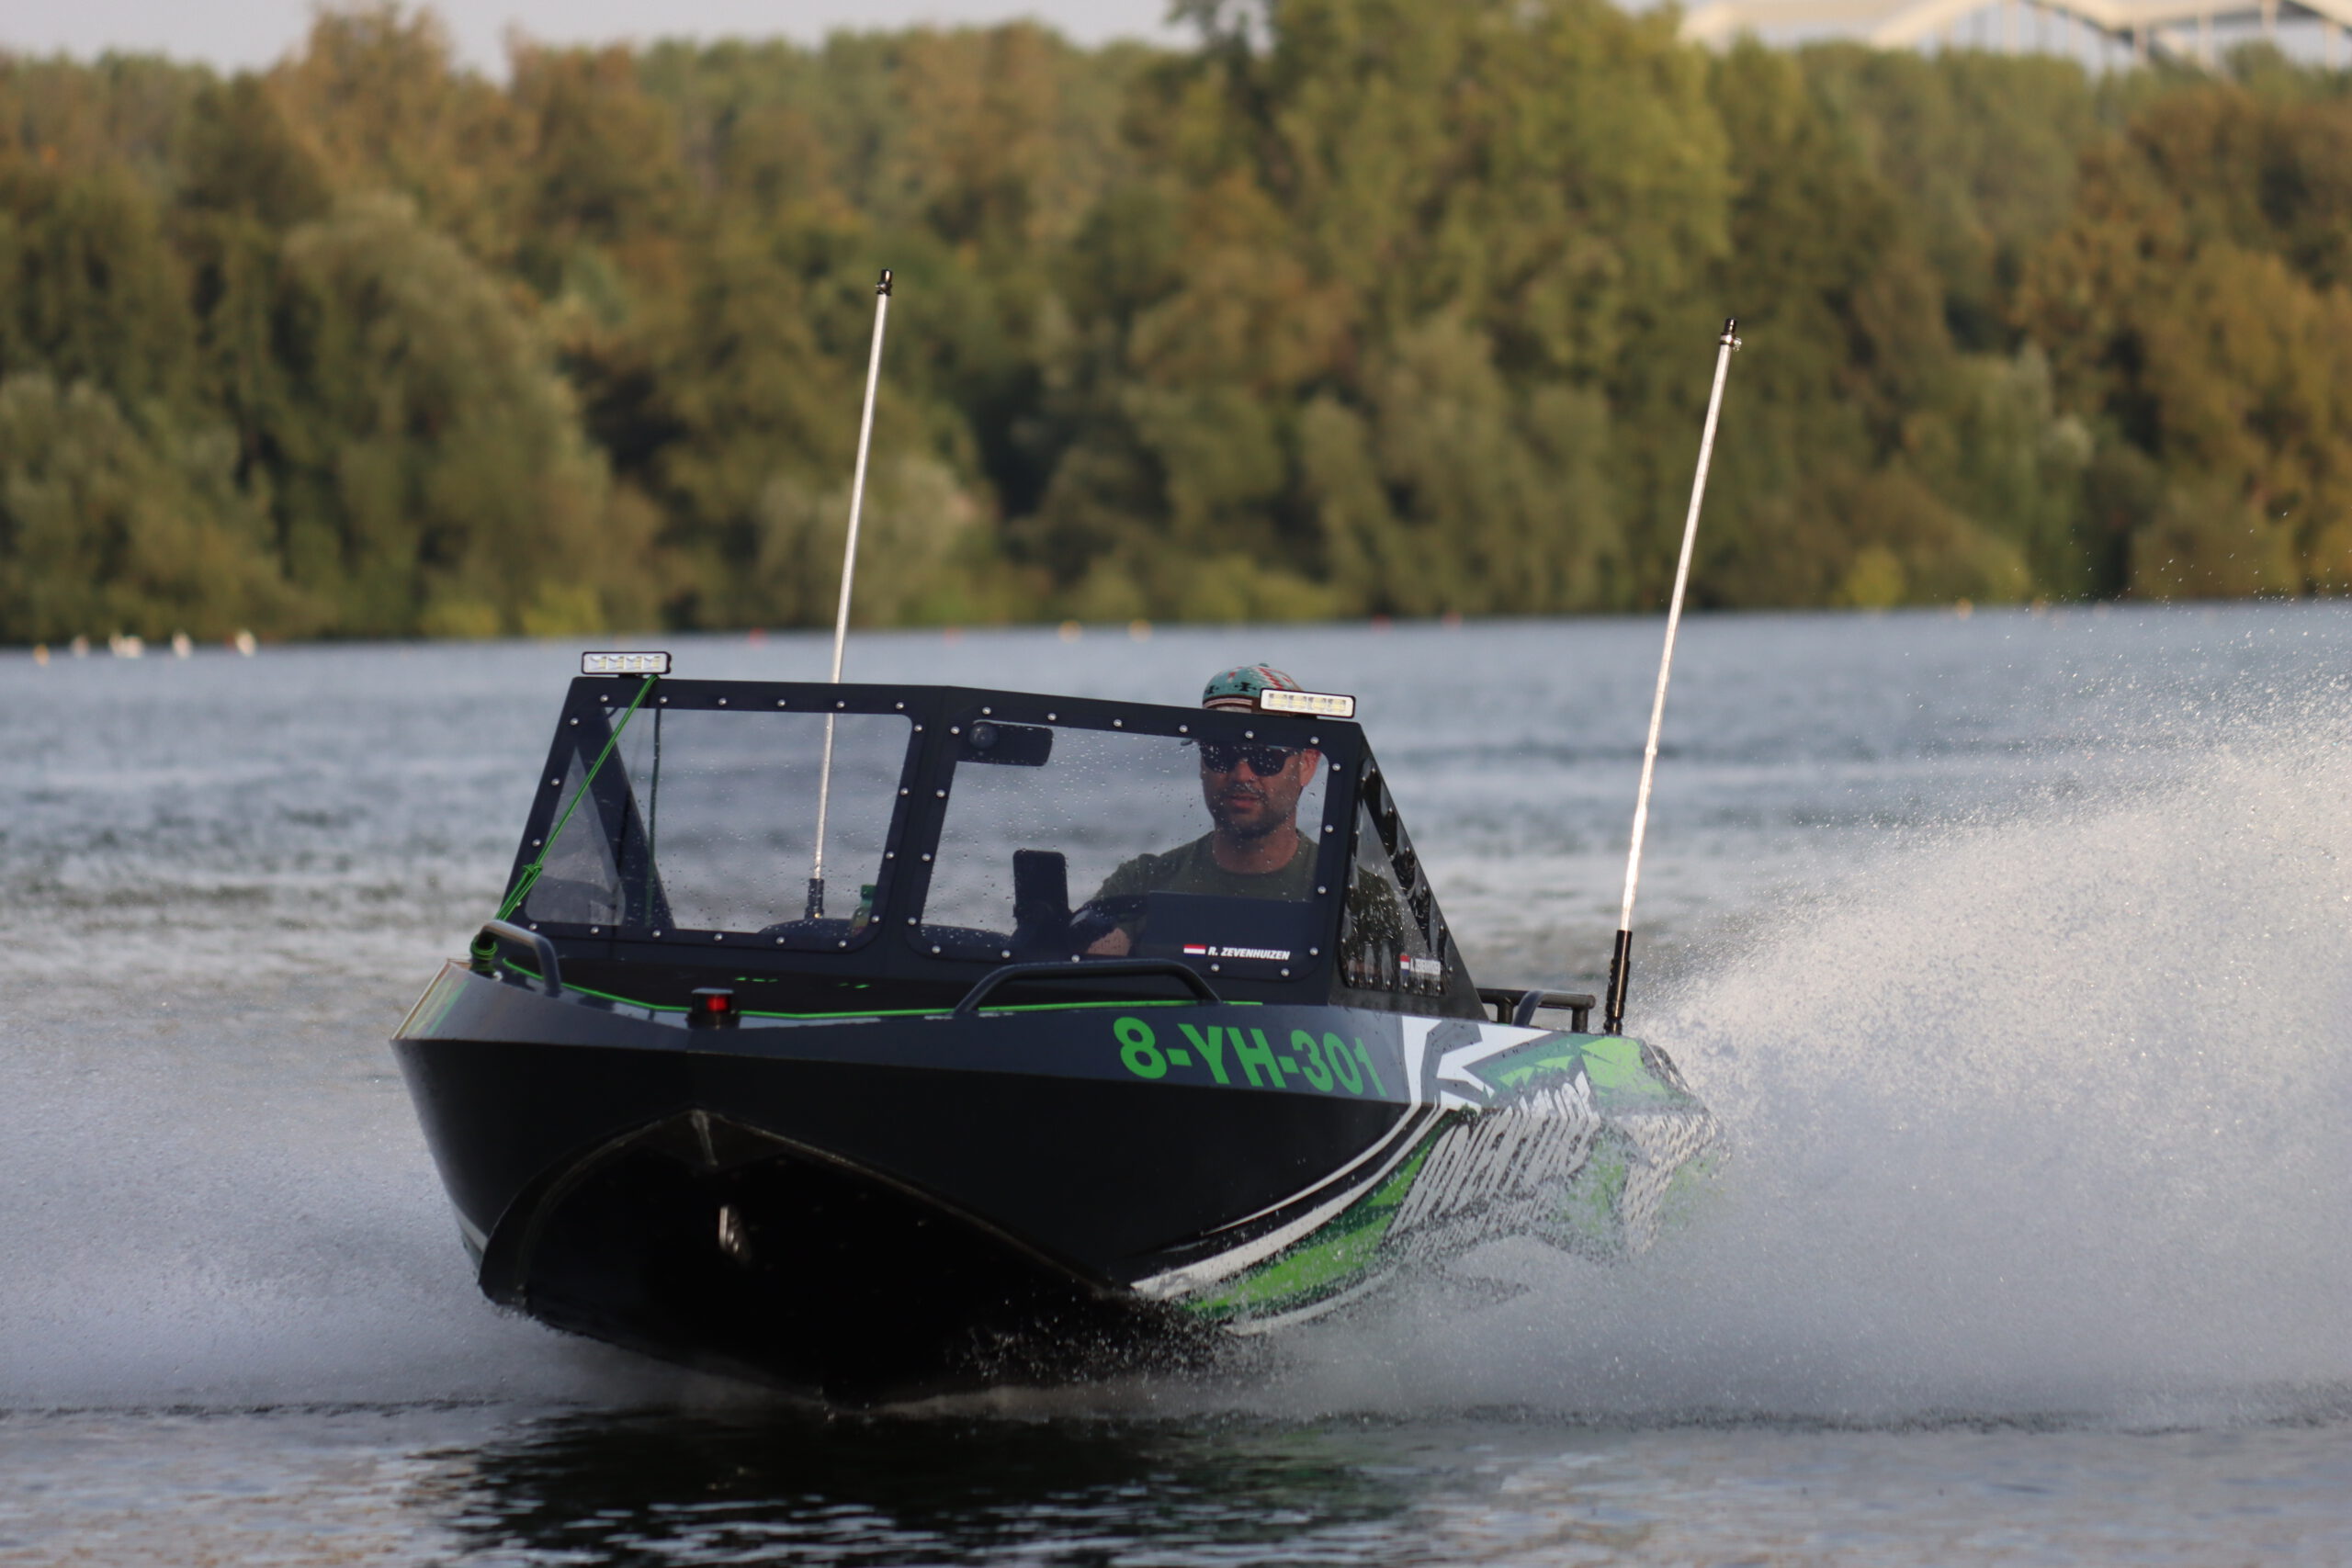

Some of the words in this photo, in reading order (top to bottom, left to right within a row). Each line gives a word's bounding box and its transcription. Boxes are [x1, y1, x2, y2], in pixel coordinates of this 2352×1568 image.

[1207, 946, 1218, 956] R.
[1220, 946, 1291, 961] ZEVENHUIZEN
[1114, 1016, 1388, 1098] 8-YH-301
